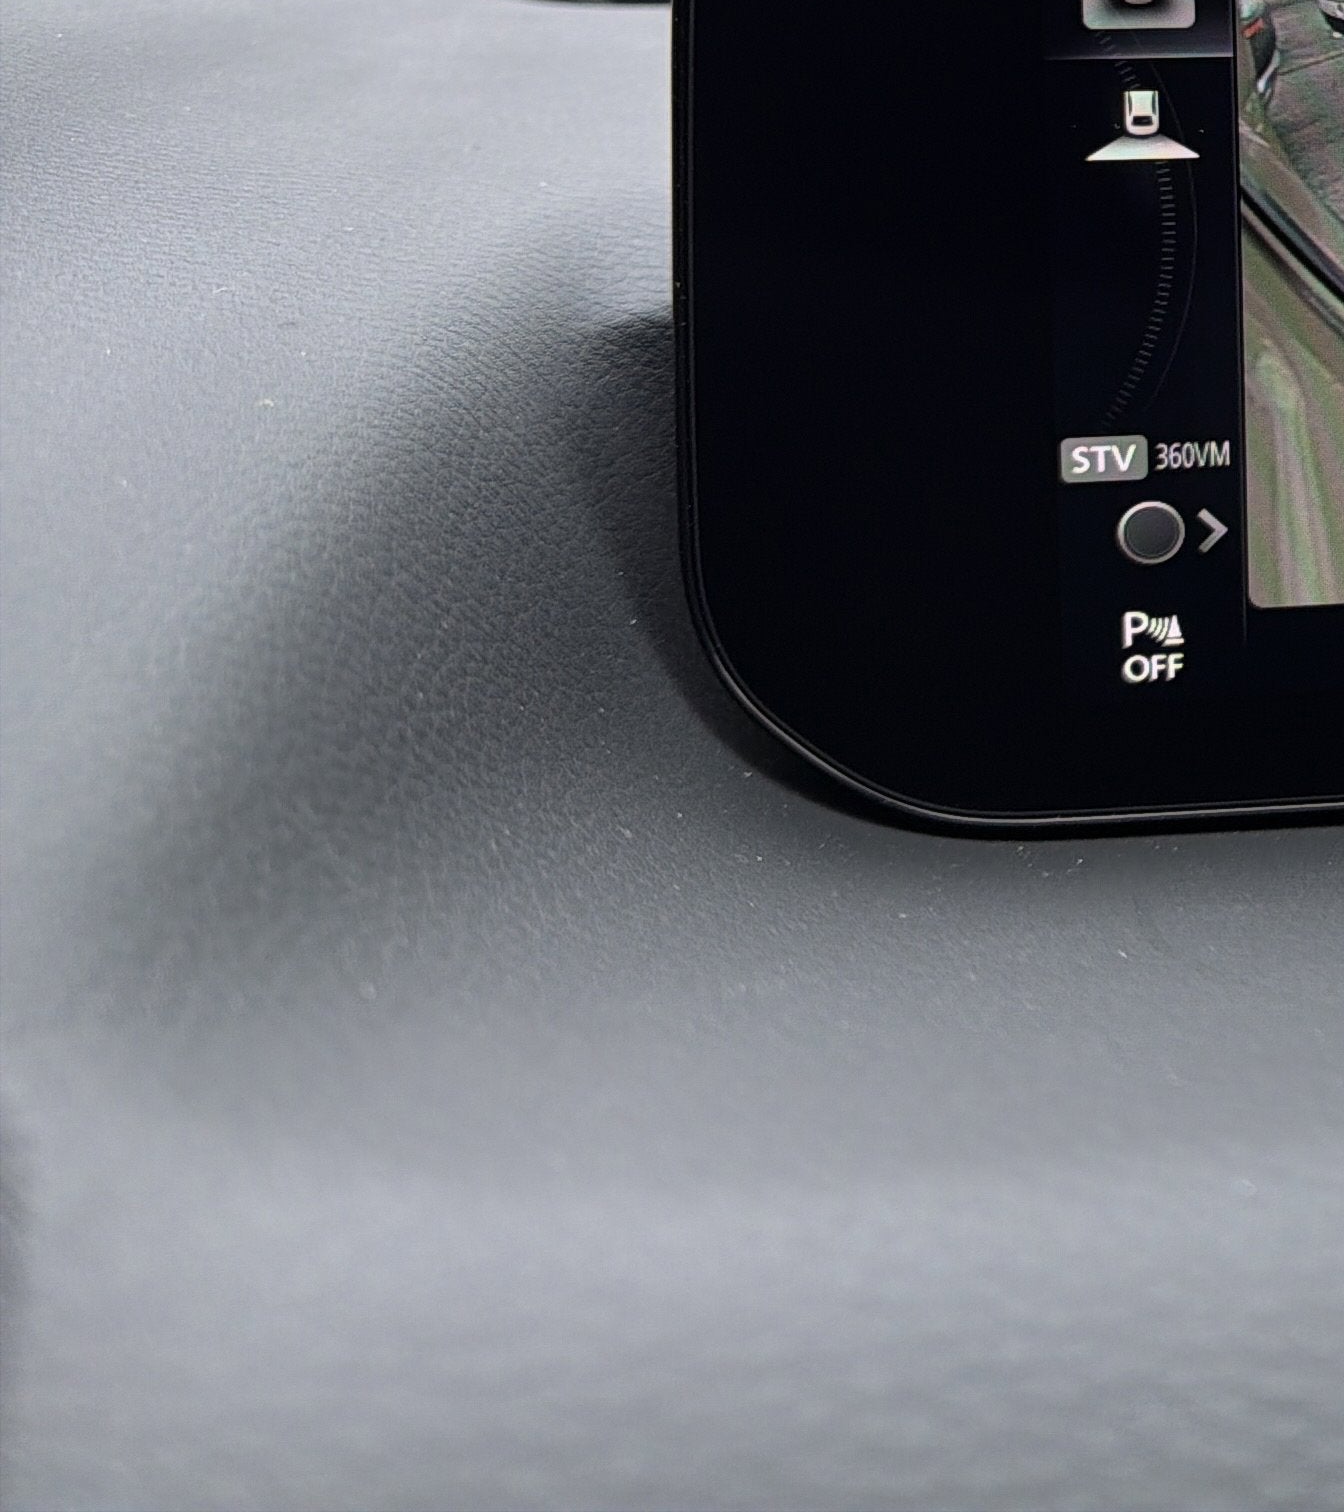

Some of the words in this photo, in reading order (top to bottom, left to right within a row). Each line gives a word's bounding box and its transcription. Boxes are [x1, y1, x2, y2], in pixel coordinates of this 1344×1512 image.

[1071, 444, 1137, 474] STV
[1154, 440, 1231, 471] 360VM
[1121, 653, 1184, 683] OFF
